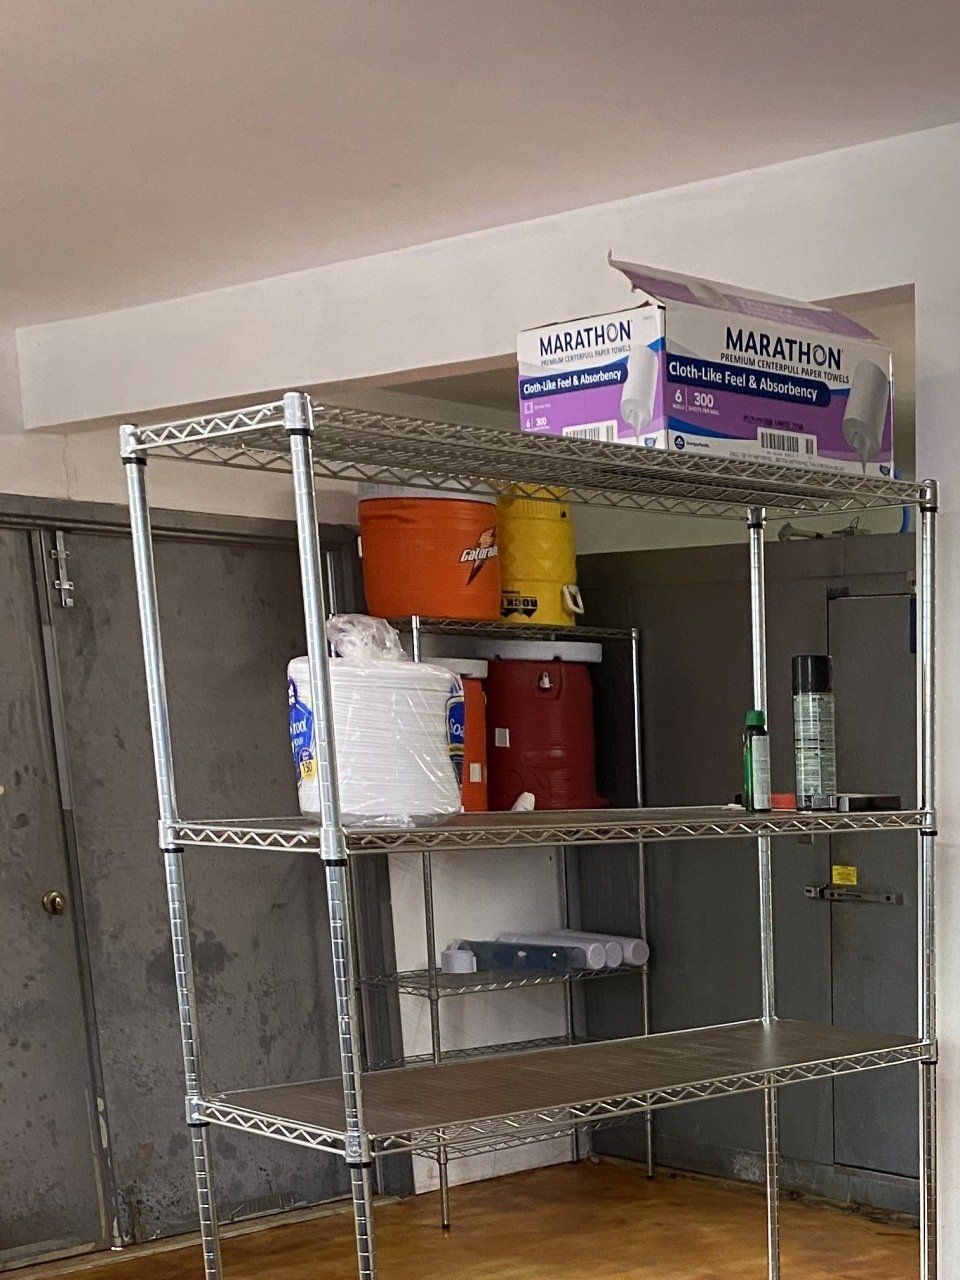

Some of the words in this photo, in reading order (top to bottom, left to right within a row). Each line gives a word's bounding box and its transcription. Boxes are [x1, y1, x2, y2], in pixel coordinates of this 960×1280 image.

[540, 320, 631, 356] MARATHON
[726, 326, 841, 370] MARATHON
[541, 357, 564, 367] PREMIUM
[565, 352, 594, 363] CENTERPULL
[595, 347, 610, 357] PAPER
[611, 344, 631, 355] TOWELS
[720, 352, 756, 368] PREMIUM
[757, 359, 799, 375] CENTERPULL
[801, 366, 822, 379] PAPER
[823, 371, 849, 384] TOWELS
[523, 380, 557, 394] Cloth-Like
[558, 377, 572, 389] Feel
[573, 375, 579, 385] &
[580, 369, 621, 384] Absorbency
[669, 361, 722, 382] Cloth-Like
[725, 371, 746, 387] Feel
[748, 376, 757, 389] &
[760, 378, 818, 402] Absorbency
[674, 389, 682, 402] 6
[693, 392, 714, 407] 300
[535, 417, 547, 426] 300
